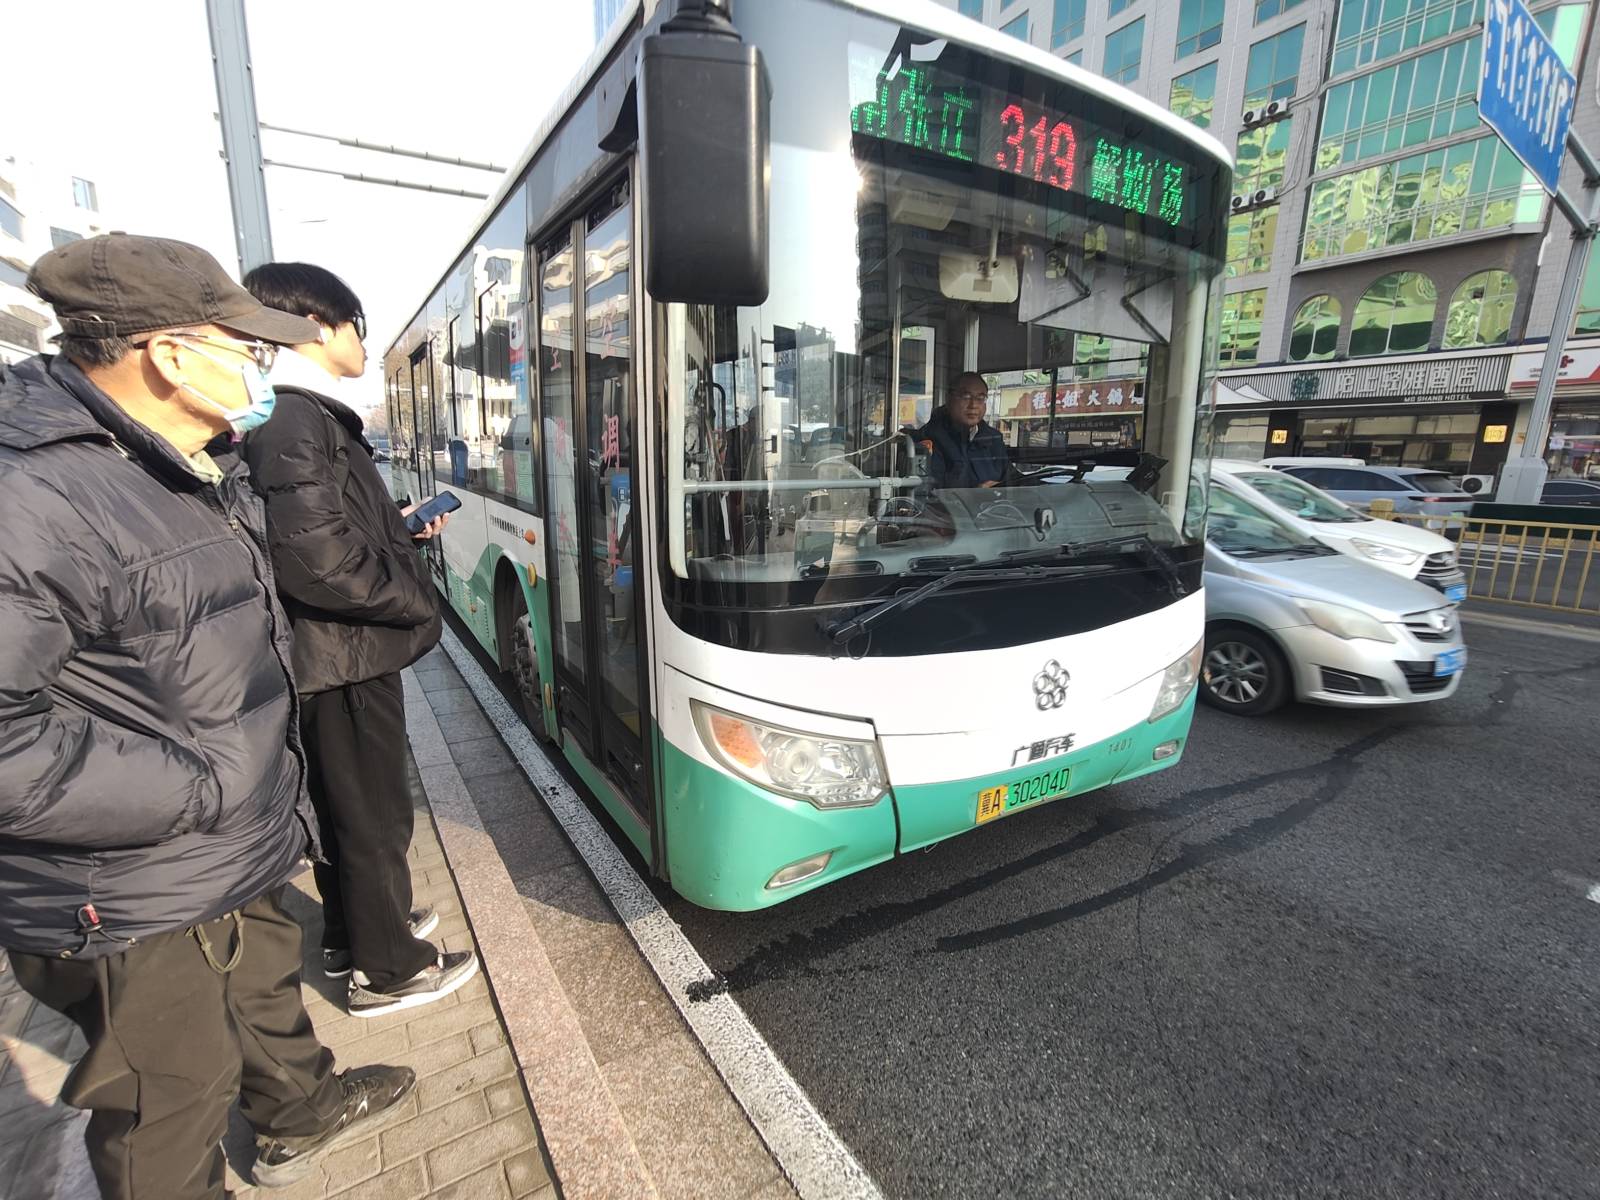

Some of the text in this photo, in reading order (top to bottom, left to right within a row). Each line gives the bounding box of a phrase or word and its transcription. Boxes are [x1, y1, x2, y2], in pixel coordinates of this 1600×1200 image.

[995, 104, 1077, 191] 319
[1444, 393, 1472, 401] HOTEL
[1009, 767, 1070, 807] 30204D
